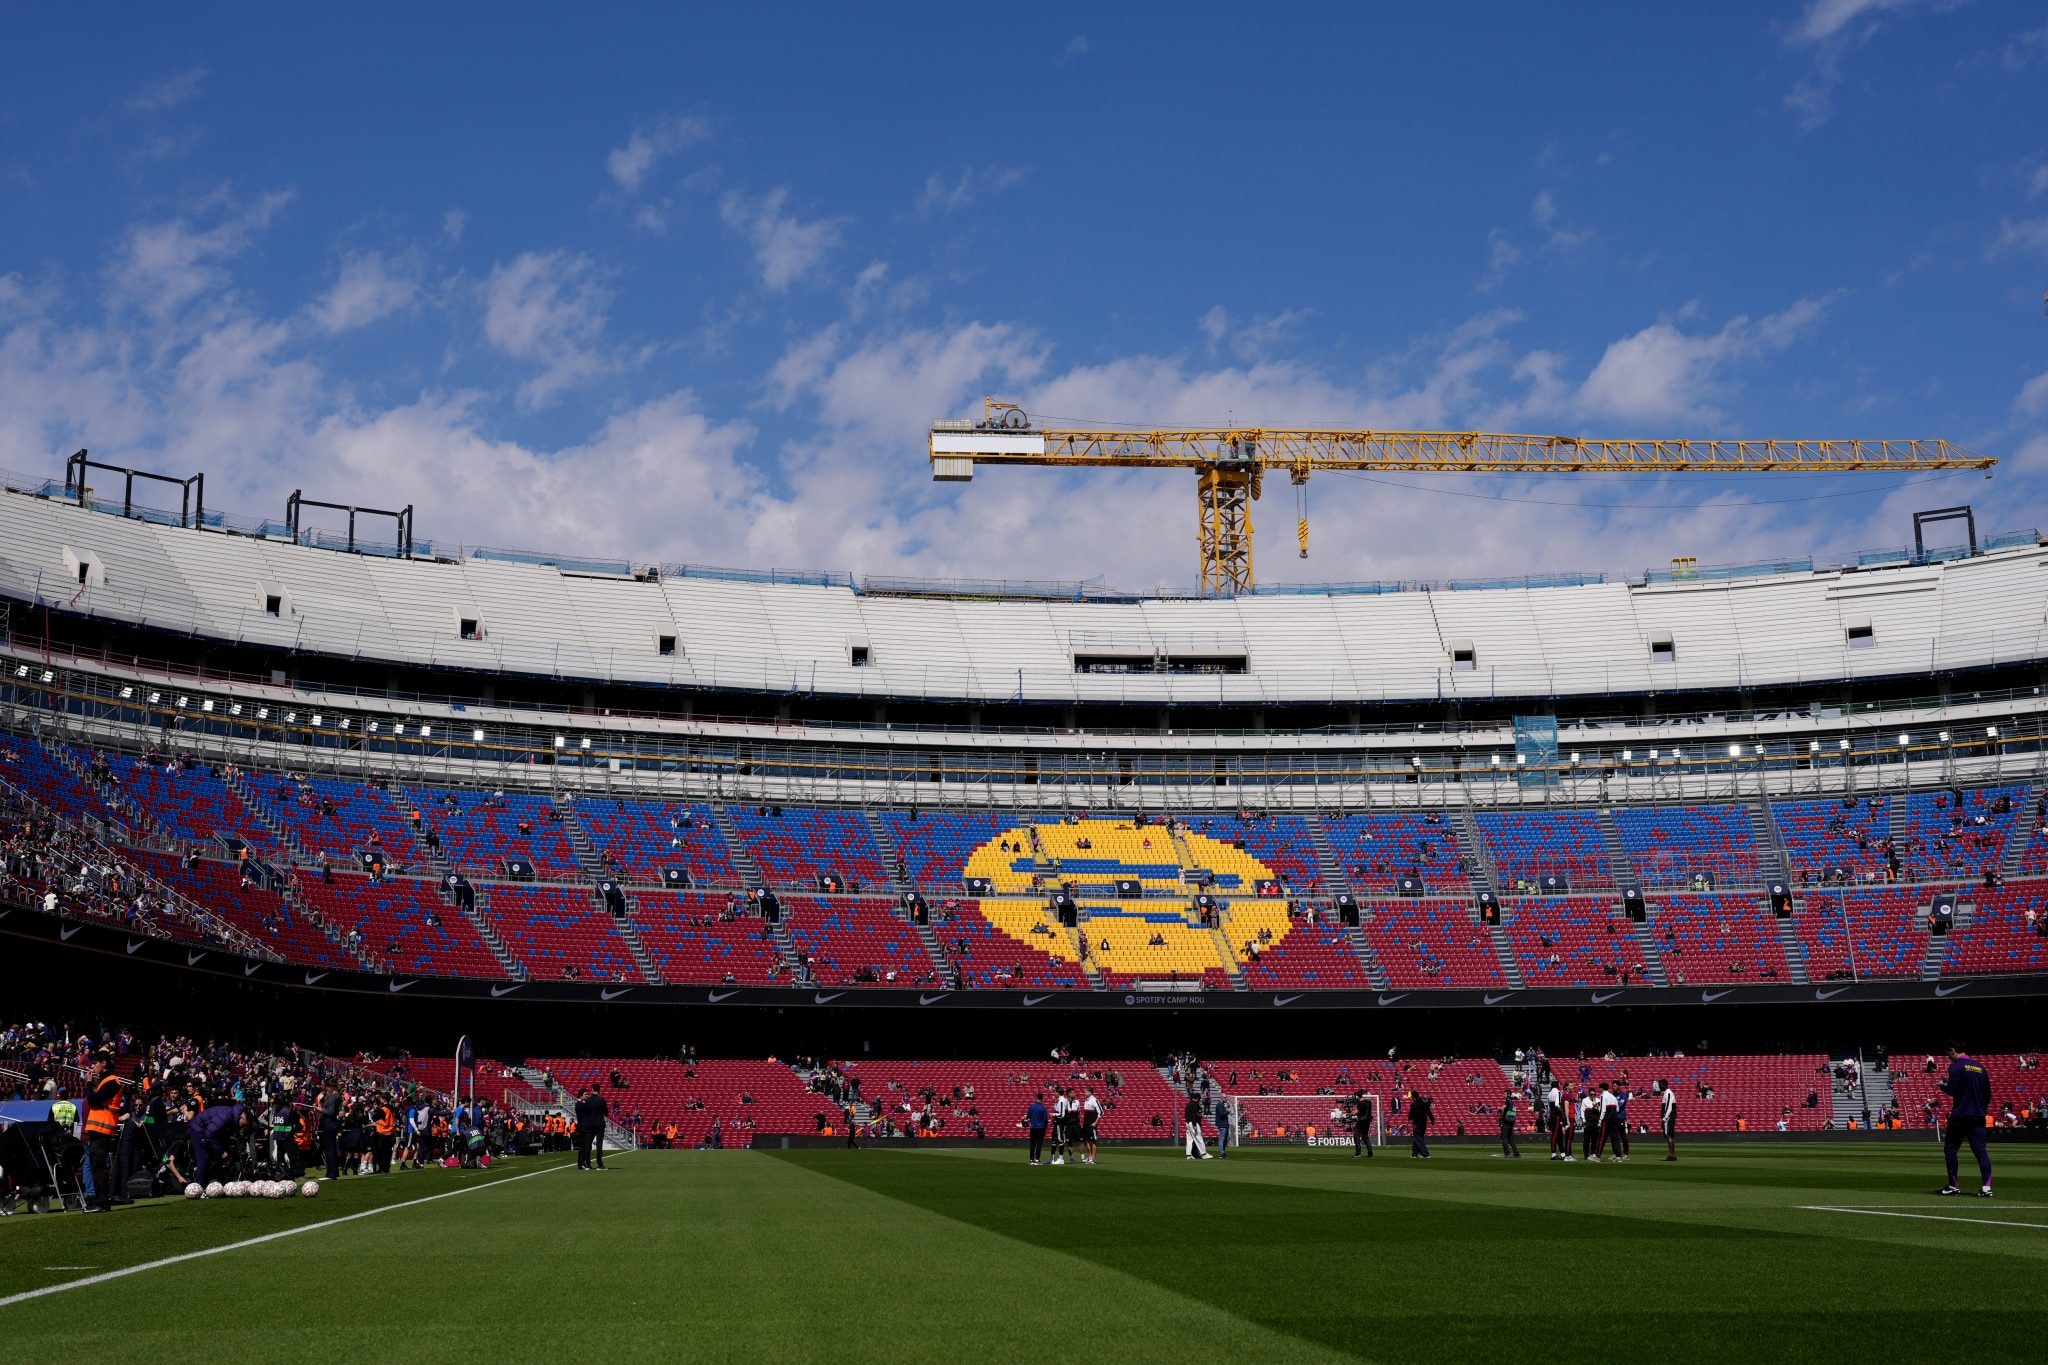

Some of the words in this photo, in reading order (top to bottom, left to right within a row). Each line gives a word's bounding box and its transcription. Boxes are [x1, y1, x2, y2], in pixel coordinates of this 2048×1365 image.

[1136, 996, 1166, 1004] SPOTIFY
[1167, 996, 1188, 1004] CAMP
[1190, 996, 1205, 1004] NOU
